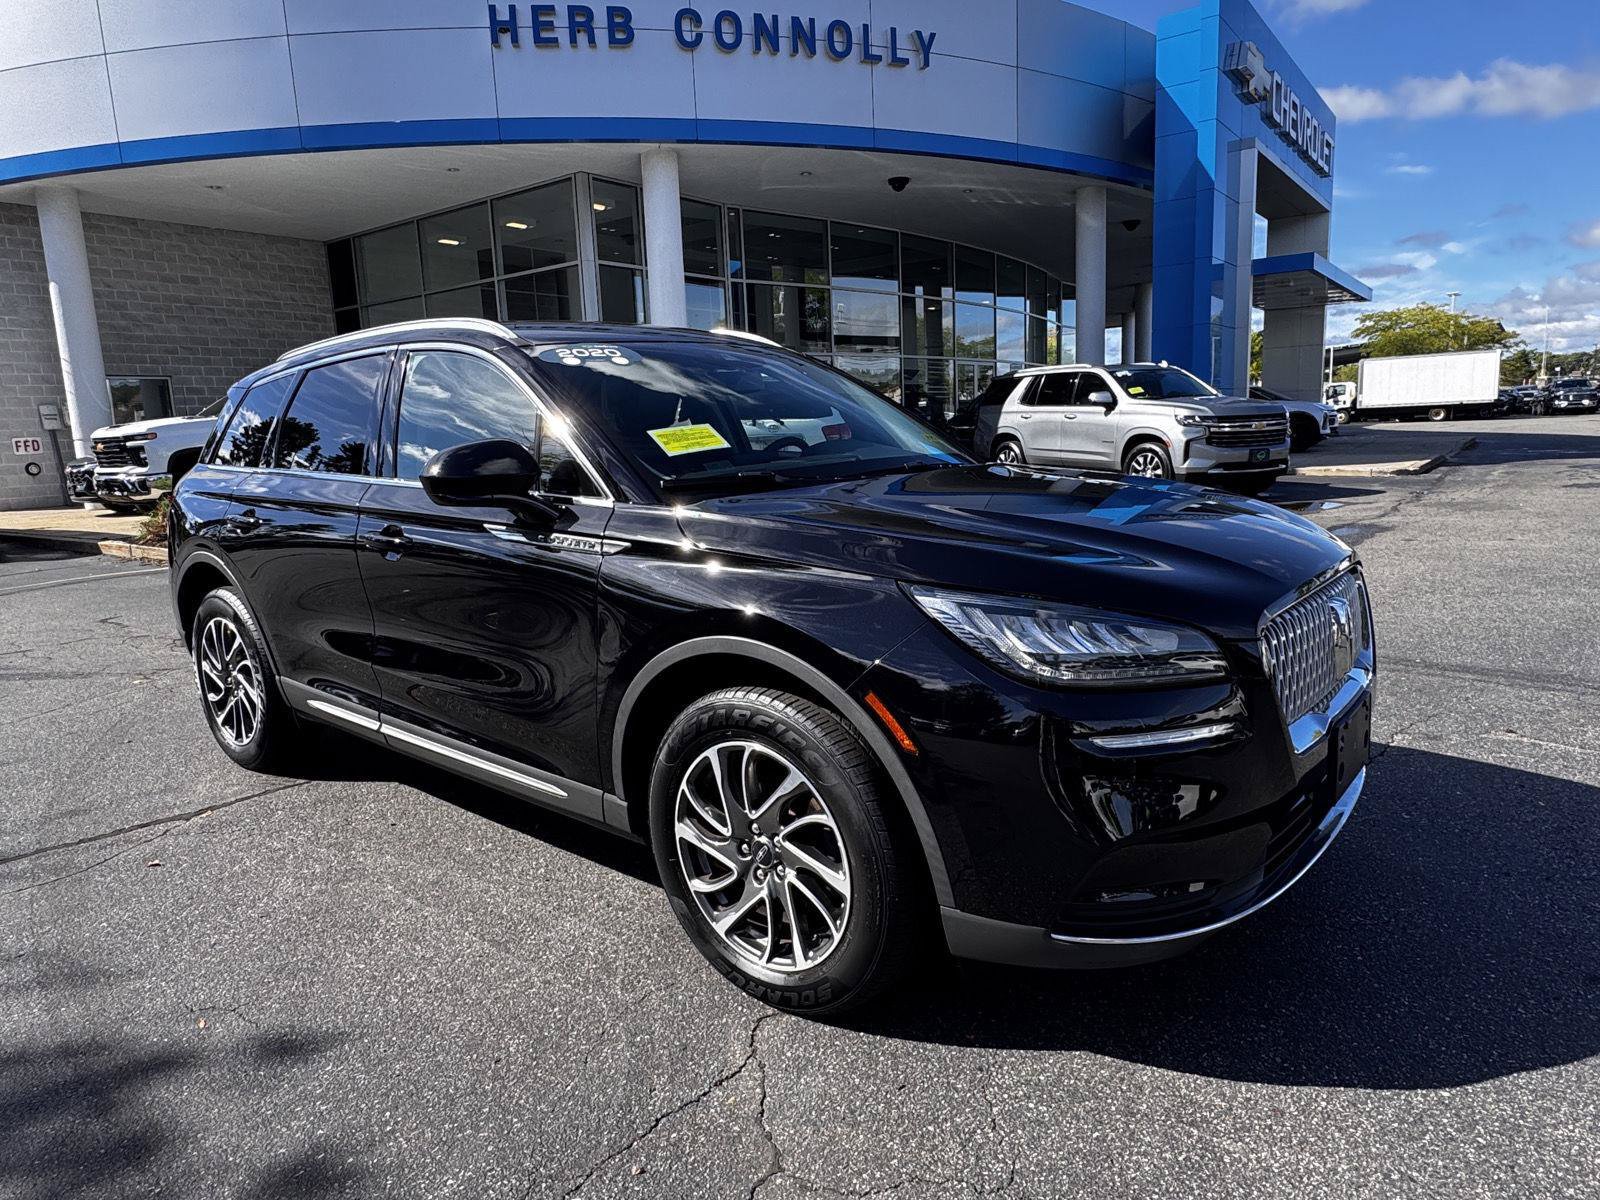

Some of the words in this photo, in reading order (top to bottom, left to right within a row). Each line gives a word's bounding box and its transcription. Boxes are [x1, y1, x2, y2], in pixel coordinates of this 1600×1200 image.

[488, 4, 635, 48] HERB
[674, 8, 937, 71] CONNOLLY
[1267, 70, 1335, 177] CHEVROLET
[556, 348, 621, 357] 2020
[15, 440, 40, 452] FFD
